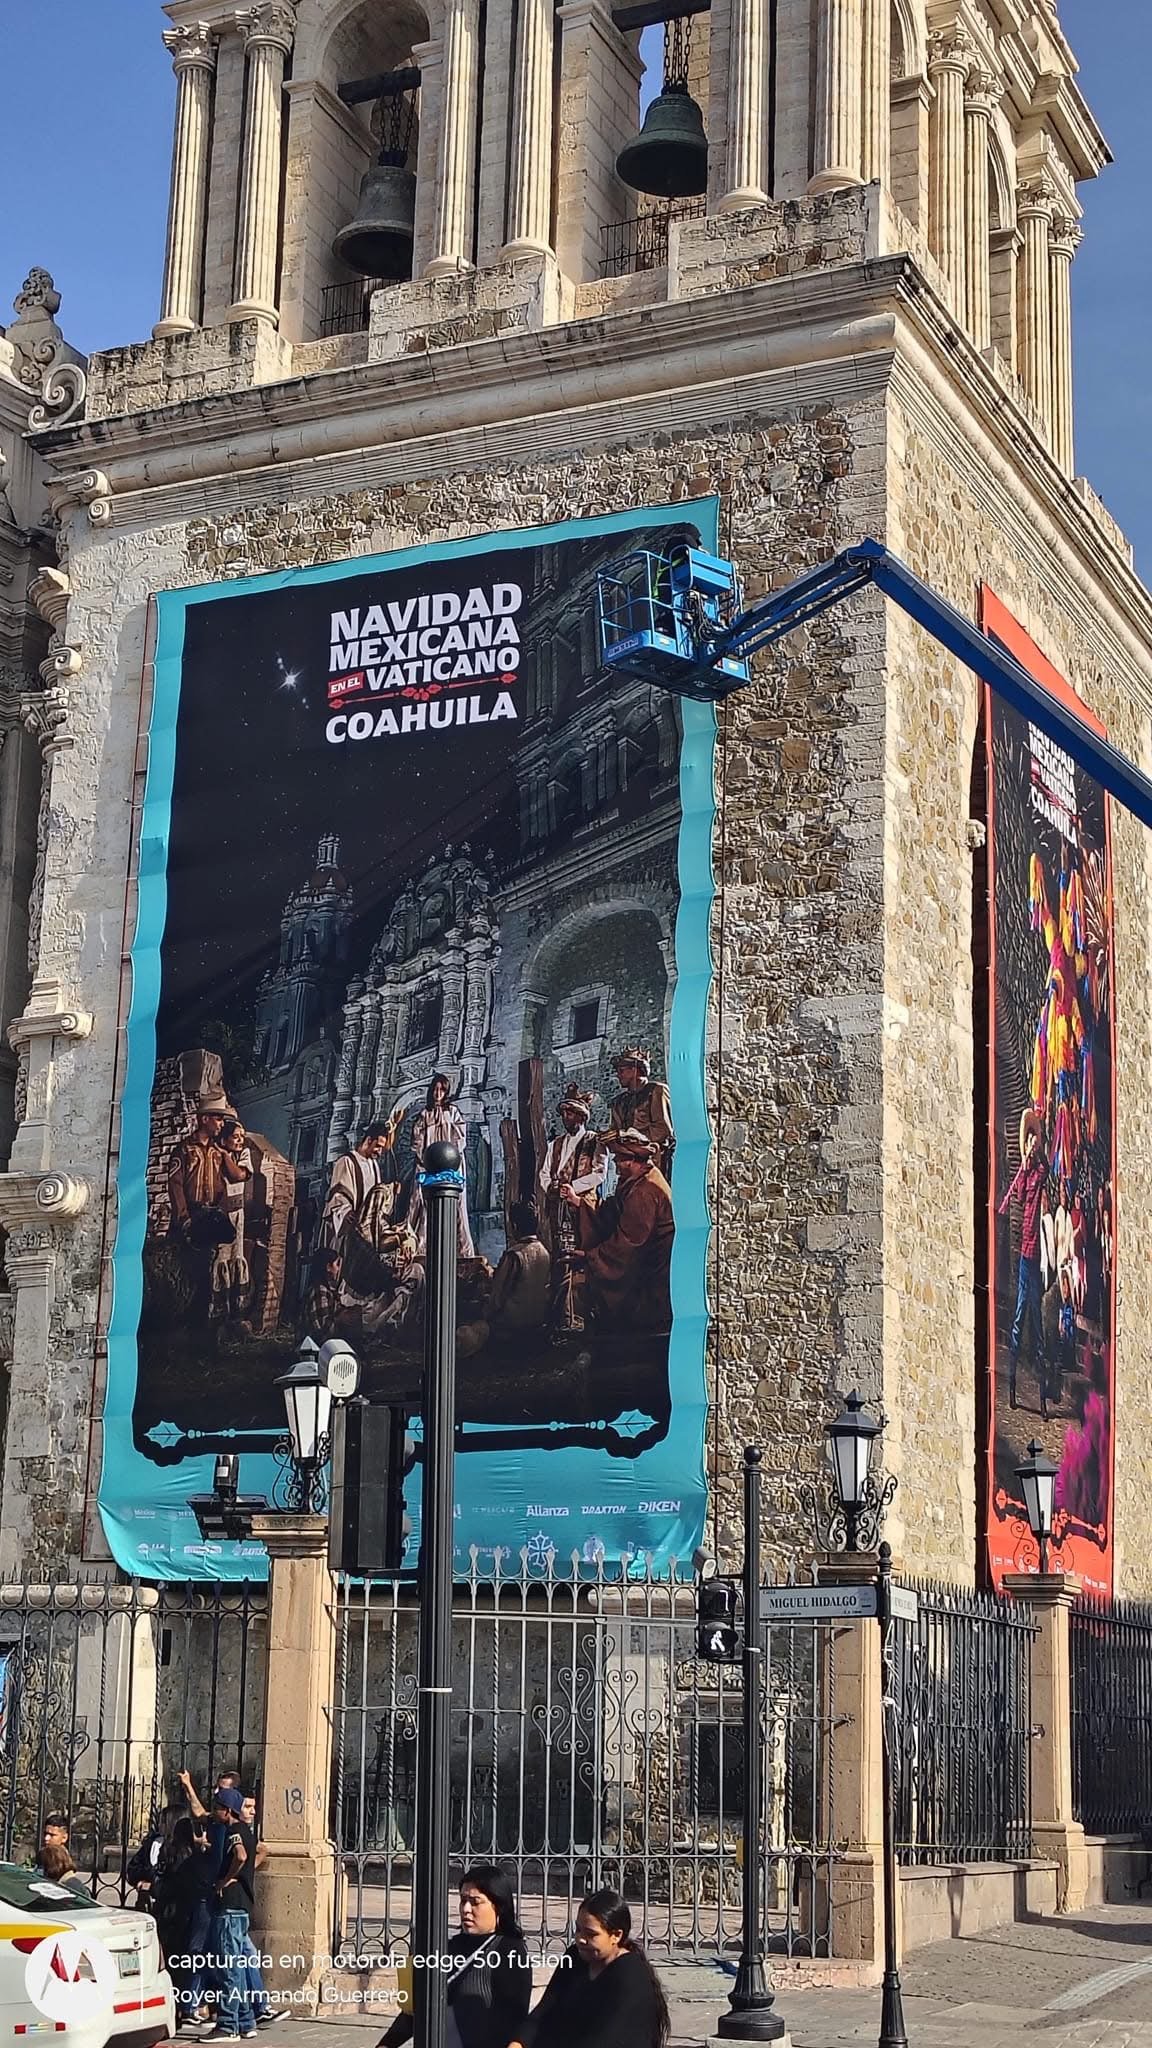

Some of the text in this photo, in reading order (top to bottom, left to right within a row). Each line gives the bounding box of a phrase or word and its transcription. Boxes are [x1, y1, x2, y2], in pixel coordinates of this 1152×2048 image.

[330, 583, 523, 643] NAVIDAD
[329, 617, 521, 672] MEXICANA
[330, 646, 521, 694] EN EL VATICANO
[326, 692, 518, 744] COAHUILA
[1029, 731, 1077, 799] MEXICANA
[1039, 763, 1077, 817] VATICANO
[1030, 784, 1078, 849] COAHUILA
[581, 1505, 627, 1515] DRAXTON
[638, 1501, 681, 1513] DIKEN
[769, 1595, 857, 1609] MIGUEL HIDALGO
[285, 1787, 303, 1815] 18
